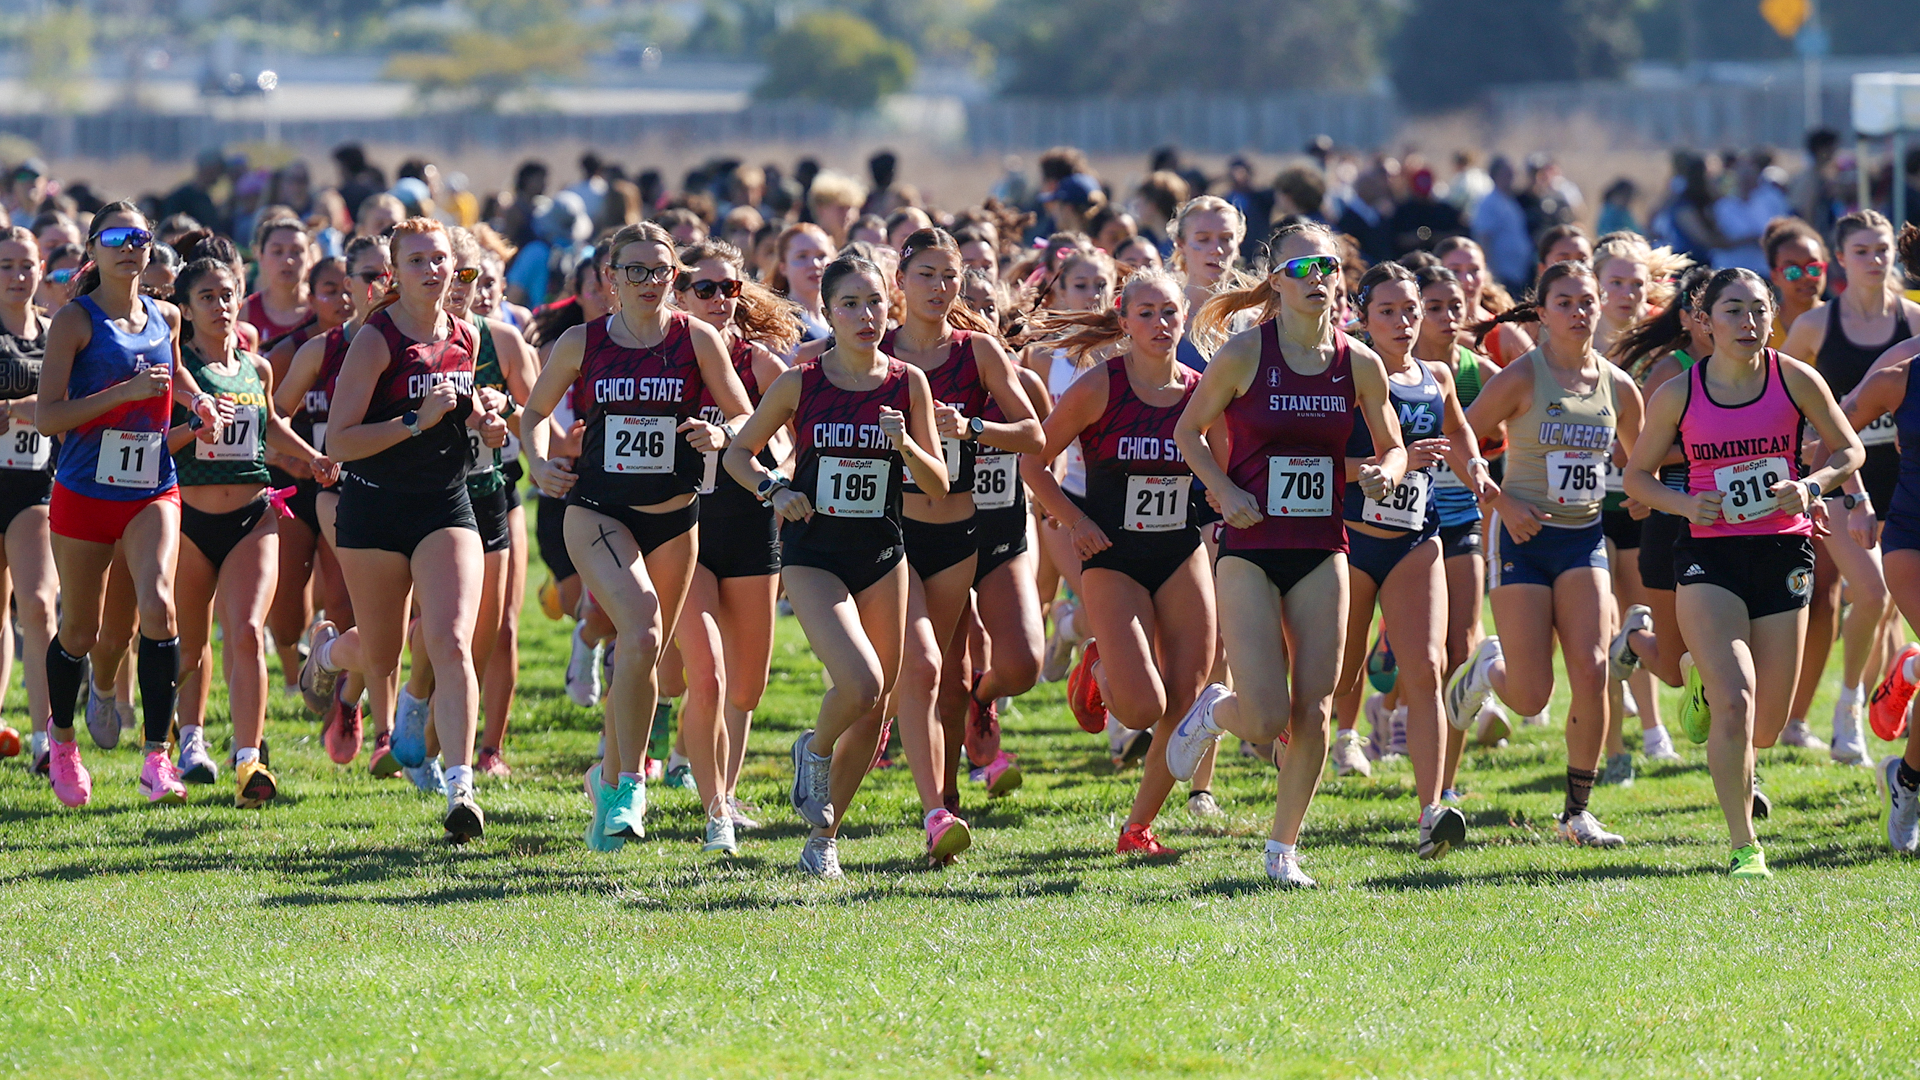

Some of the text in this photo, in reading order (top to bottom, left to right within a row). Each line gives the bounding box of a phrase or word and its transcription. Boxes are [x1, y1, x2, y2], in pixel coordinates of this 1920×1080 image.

[214, 392, 266, 407] BOLD
[595, 377, 684, 403] CHICO STATE
[1269, 394, 1347, 413] STANFORD
[623, 417, 659, 427] MileSplit
[1400, 402, 1436, 435] MB
[14, 430, 40, 454] 30
[215, 420, 250, 445] 07
[615, 430, 664, 458] 246
[813, 423, 898, 450] CHICO STA
[1539, 422, 1561, 445] UC
[120, 445, 144, 472] 11
[1117, 436, 1160, 460] CHICO
[1691, 434, 1790, 460] DOMINICAN
[838, 459, 873, 469] MileSplit
[1289, 458, 1321, 468] MileSplit
[1732, 459, 1768, 474] MileSplit
[830, 473, 877, 501] 195
[972, 468, 1006, 494] 36
[1145, 477, 1178, 486] MileSplit
[1280, 471, 1325, 500] 703
[1558, 464, 1597, 490] 795
[1729, 471, 1779, 507] 319
[1136, 489, 1178, 516] 211
